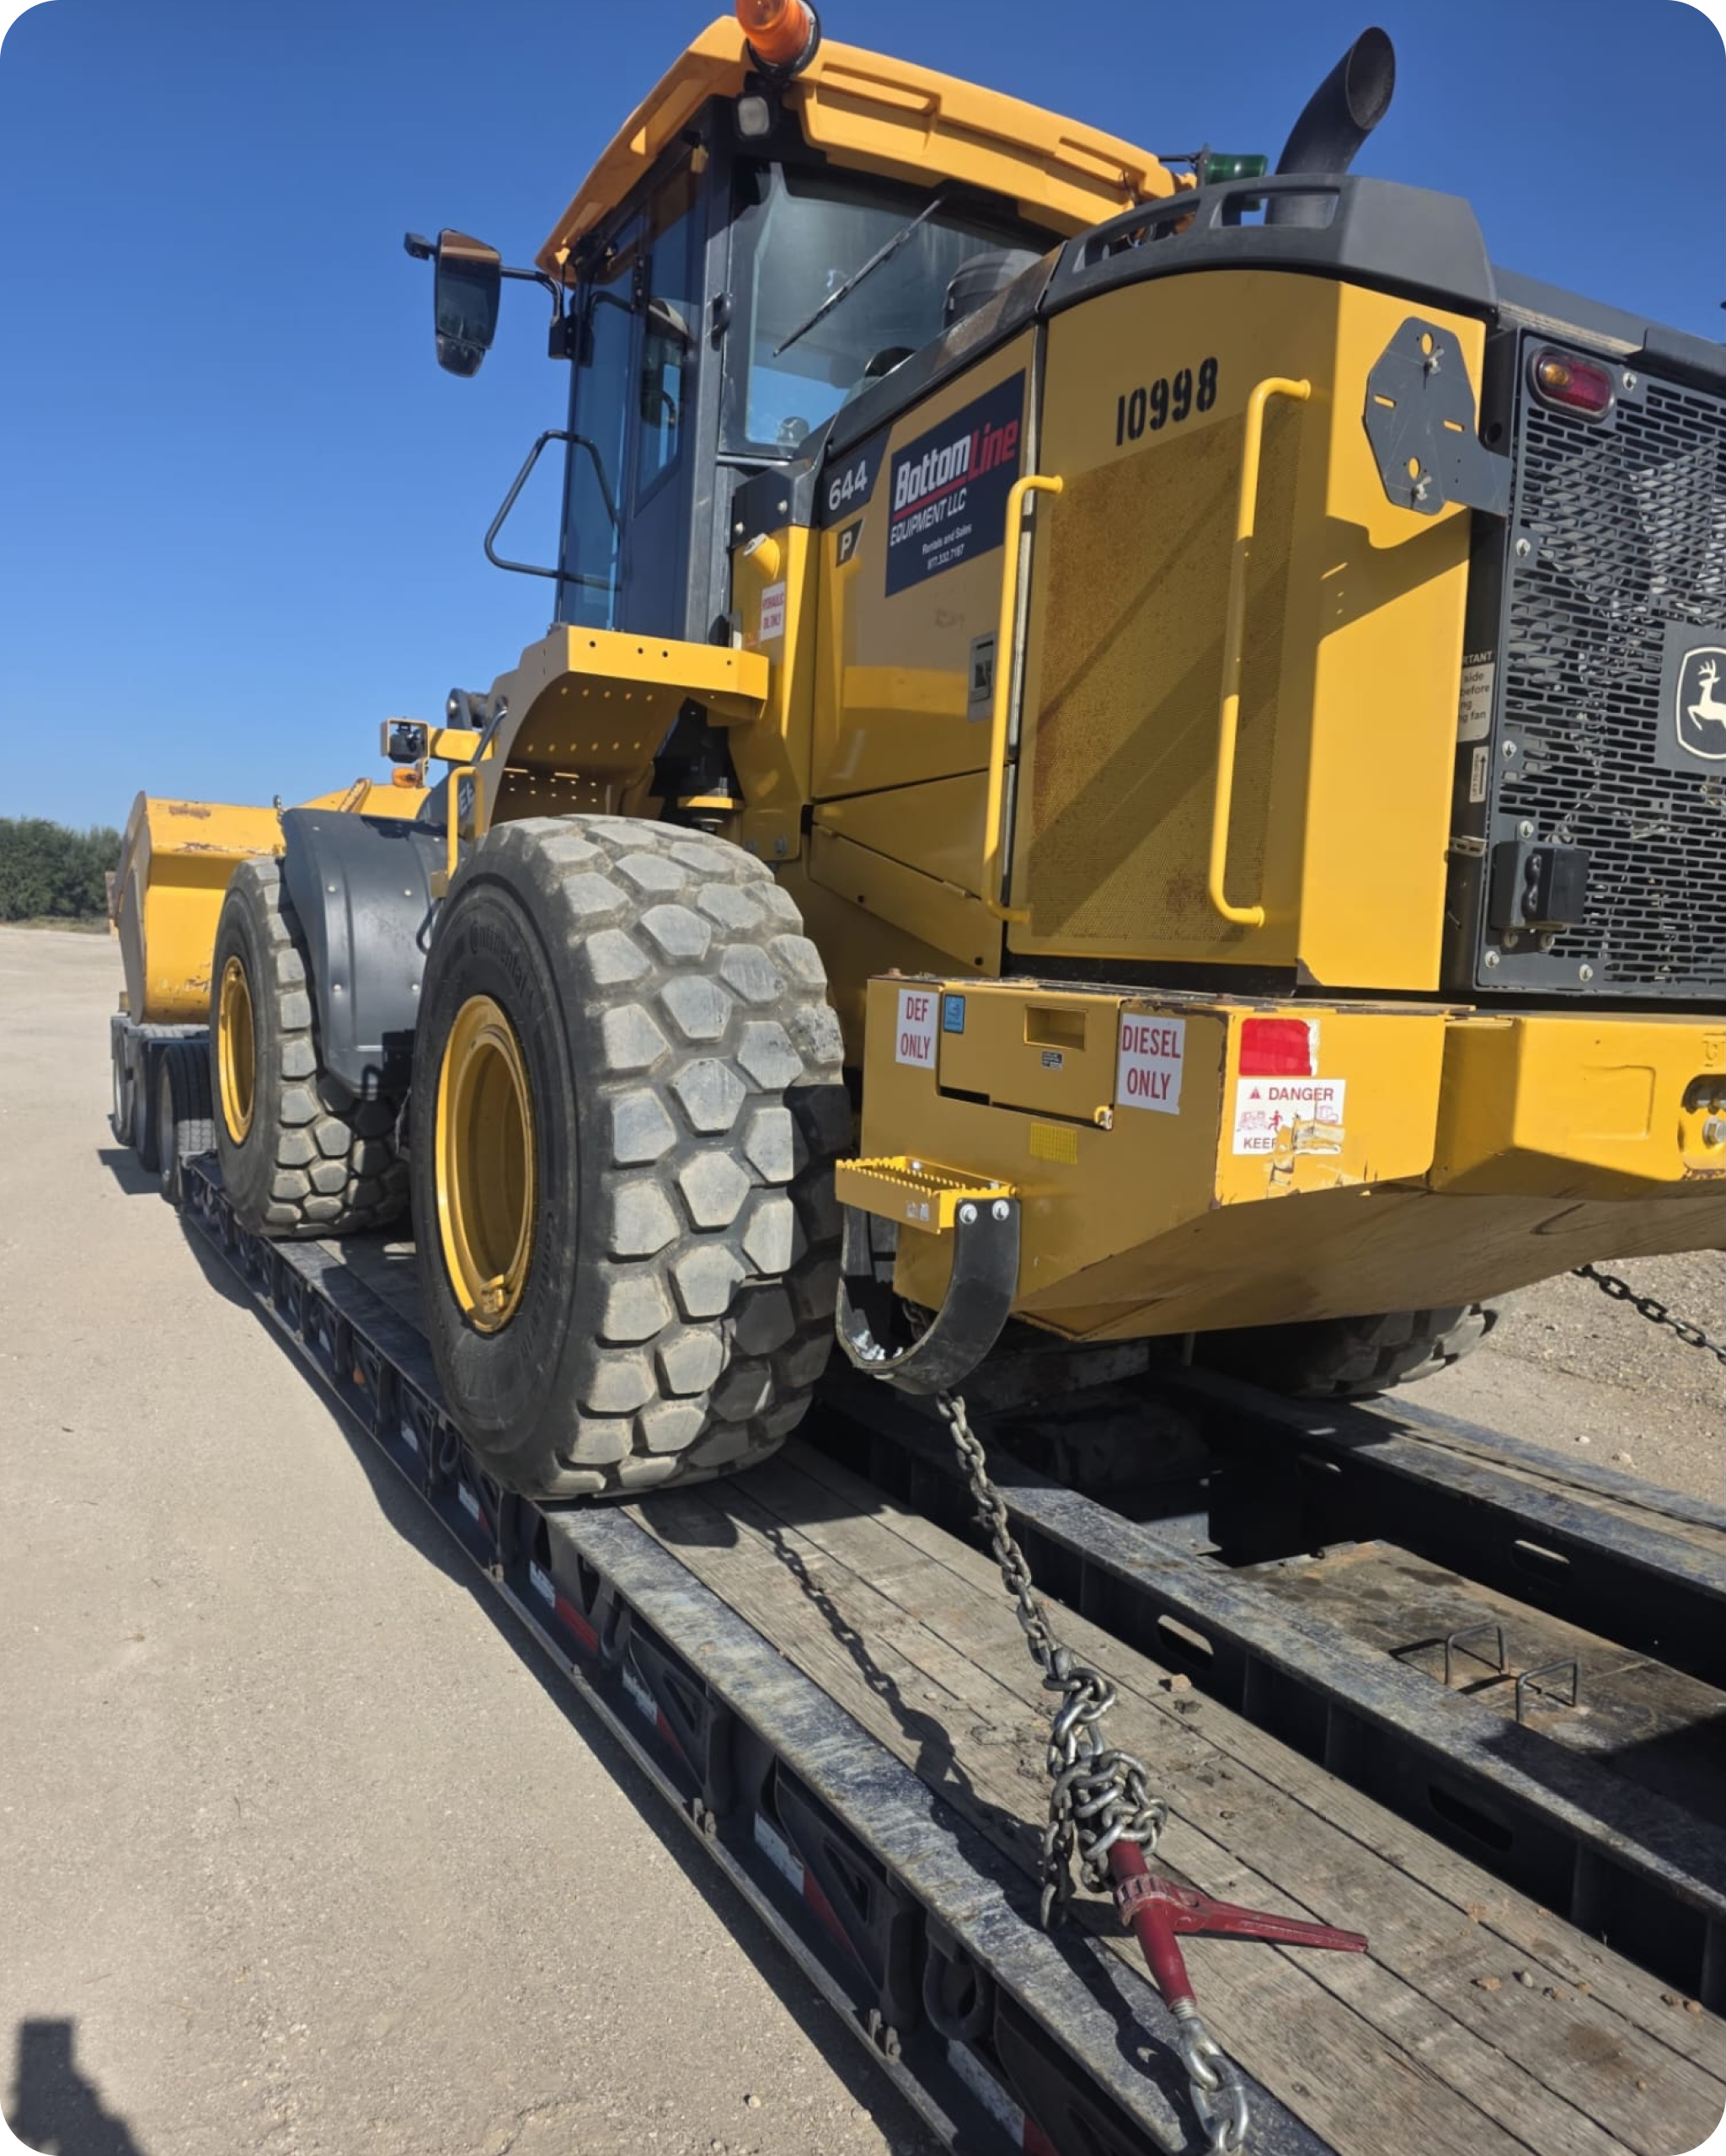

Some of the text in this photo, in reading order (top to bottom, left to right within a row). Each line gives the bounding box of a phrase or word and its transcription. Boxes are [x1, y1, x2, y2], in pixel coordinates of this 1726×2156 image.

[1115, 356, 1218, 447] 10998
[894, 419, 1019, 511] BottomLine
[829, 460, 868, 511] 644
[890, 488, 967, 547] EQUIPMENT LLC
[840, 530, 852, 561] P
[1463, 650, 1493, 666] RTANT
[906, 997, 929, 1022] DEF
[900, 1032, 931, 1061] ONLY
[1121, 1025, 1182, 1059] DIESEL
[1127, 1067, 1172, 1100] ONLY
[1268, 1087, 1334, 1102] DANGER
